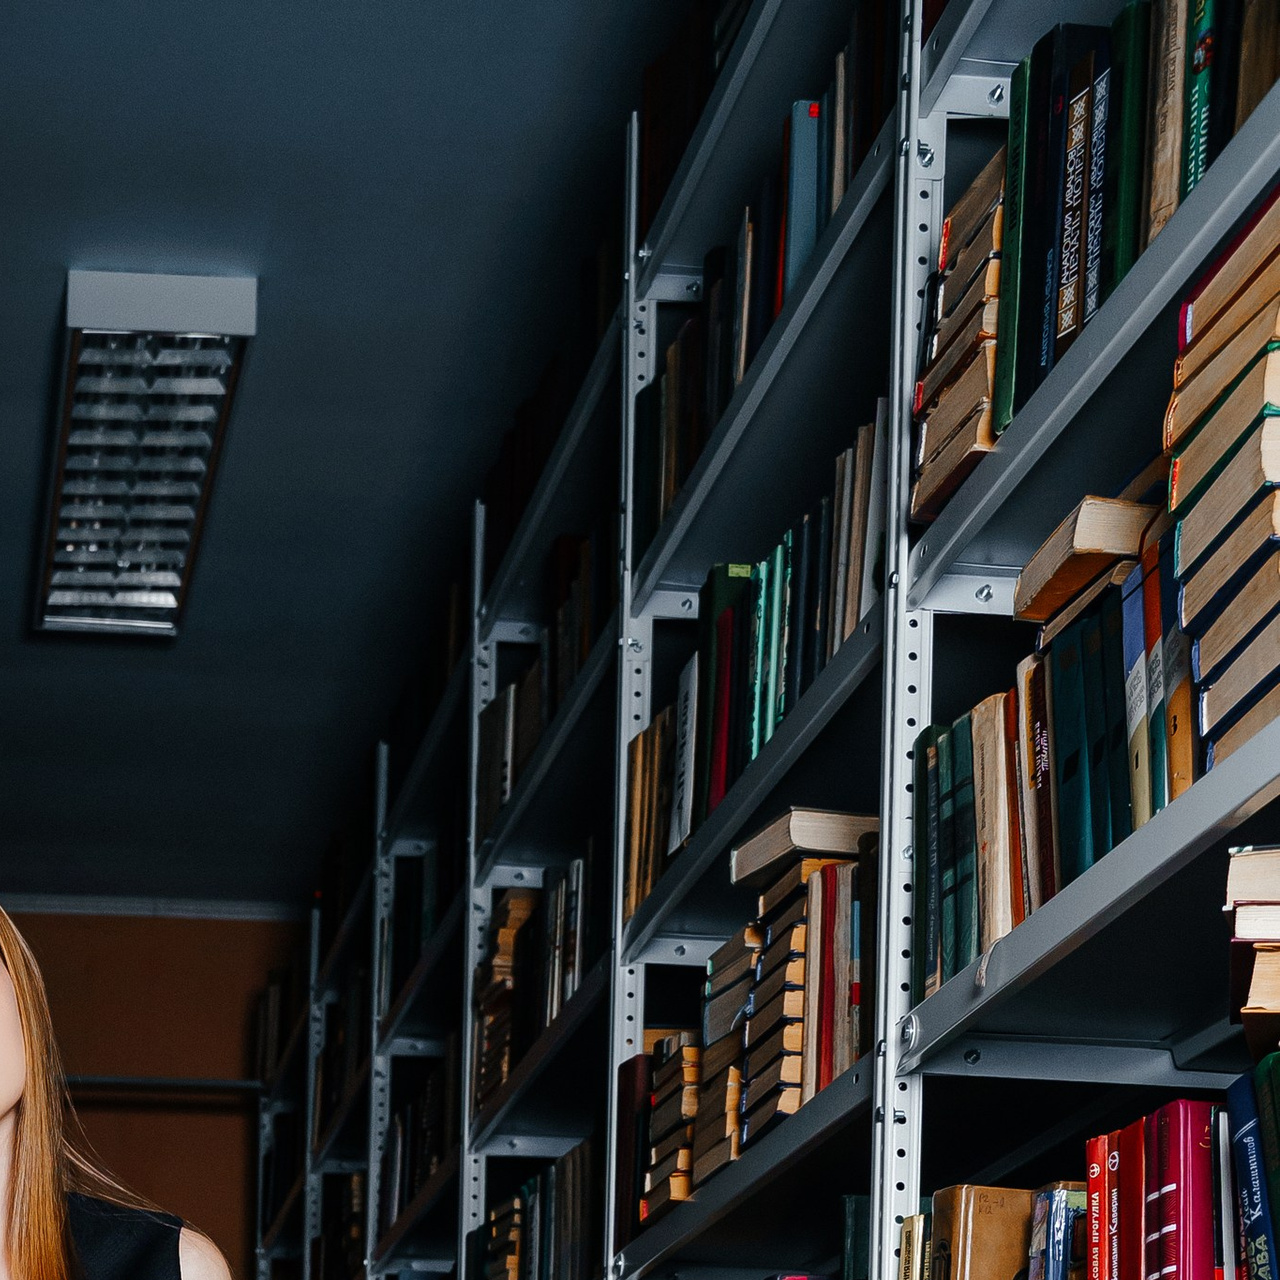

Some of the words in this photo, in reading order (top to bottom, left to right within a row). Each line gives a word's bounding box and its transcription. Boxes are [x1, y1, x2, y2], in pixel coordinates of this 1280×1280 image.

[1064, 149, 1077, 208] ИВАНОВ
[1060, 210, 1073, 284] АНАТОЛИЙ
[1068, 210, 1081, 283] ПЕЧАЛЬ
[1090, 1191, 1100, 1244] ПРОГУЛКА
[1109, 1188, 1119, 1235] Каверин
